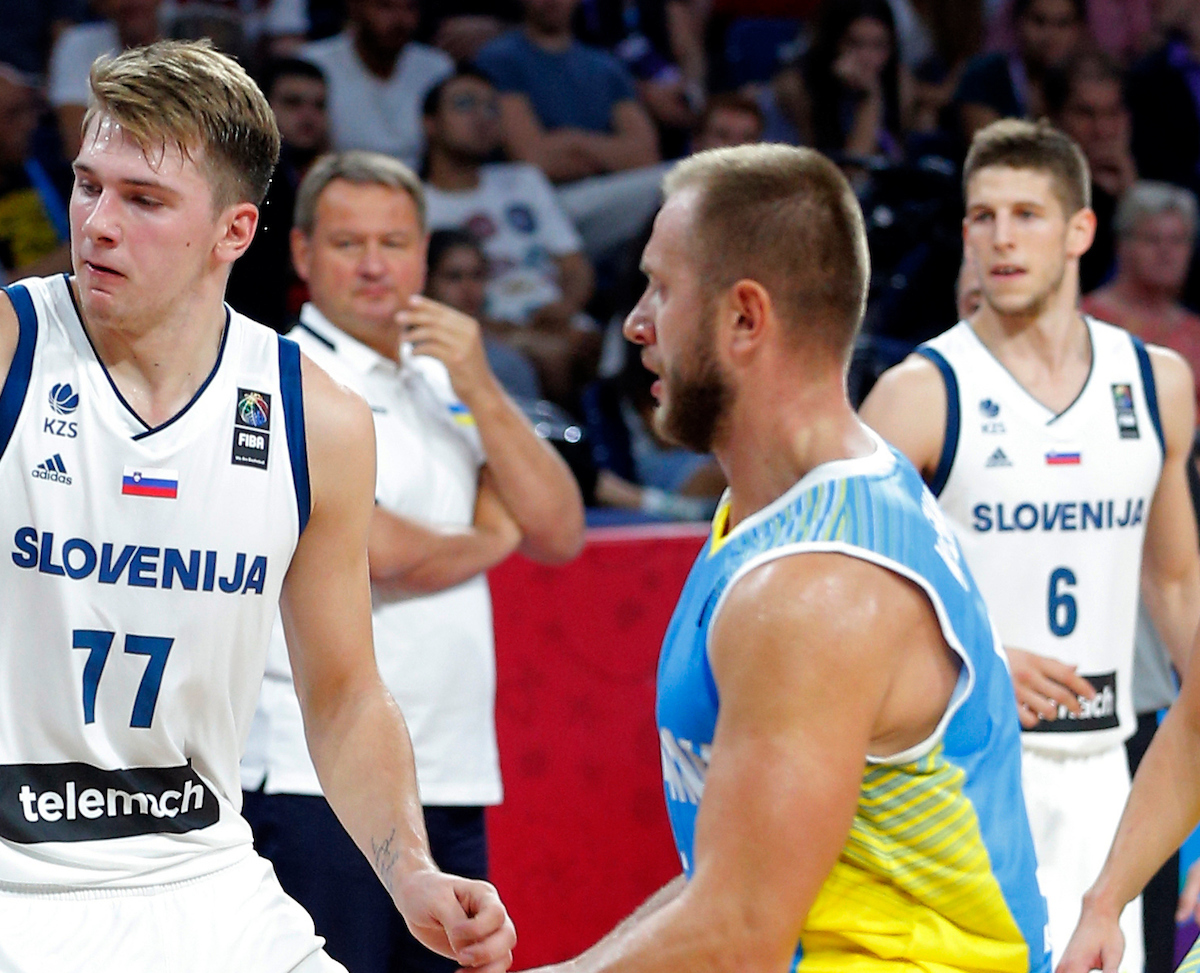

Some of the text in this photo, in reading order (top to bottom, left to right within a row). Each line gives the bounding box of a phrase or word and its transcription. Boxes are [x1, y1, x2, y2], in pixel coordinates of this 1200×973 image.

[43, 417, 78, 438] KZS
[237, 432, 265, 450] FIBA
[31, 468, 73, 486] adidas
[973, 500, 1145, 533] SLOVENIJA
[11, 526, 268, 595] SLOVENIJA
[1048, 567, 1078, 637] 6
[72, 629, 176, 729] 77
